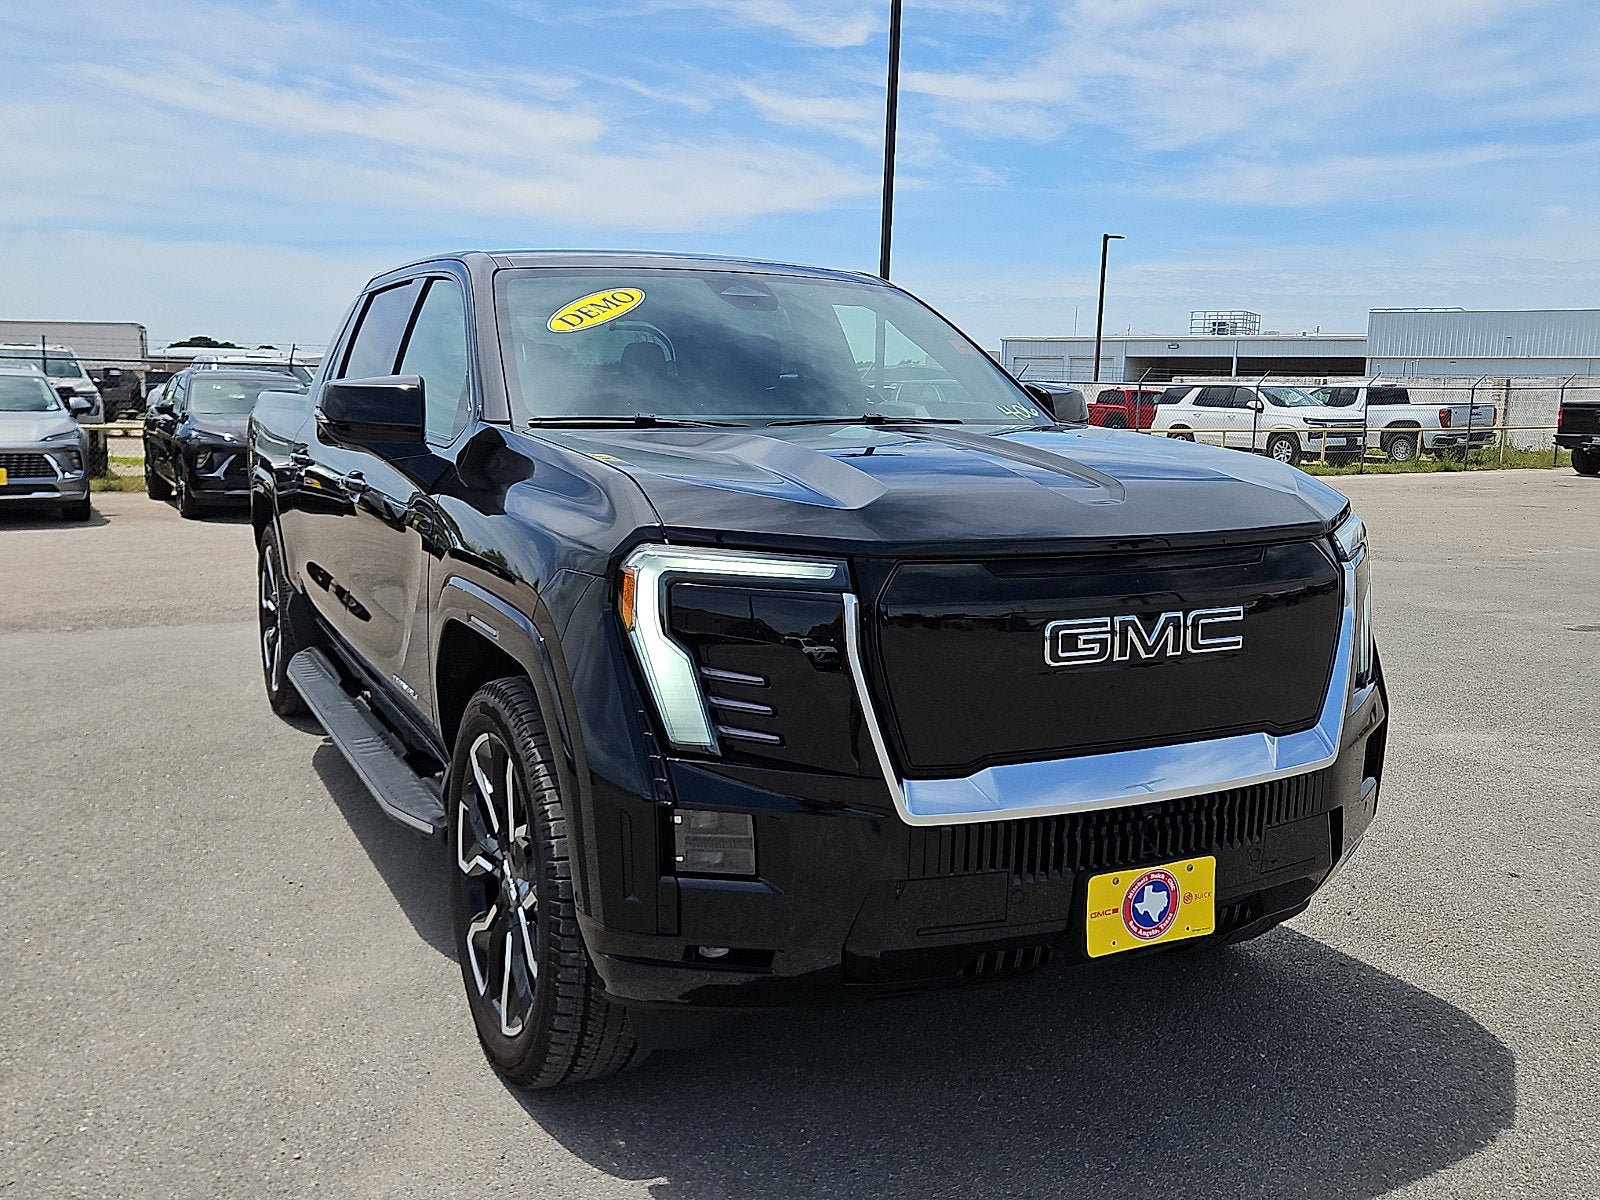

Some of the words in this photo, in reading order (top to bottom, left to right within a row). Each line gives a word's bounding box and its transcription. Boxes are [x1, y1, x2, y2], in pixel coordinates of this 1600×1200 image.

[556, 291, 634, 328] DEMO
[1044, 605, 1244, 667] GMC
[1194, 891, 1212, 900] BUICK
[1090, 909, 1112, 919] GMC
